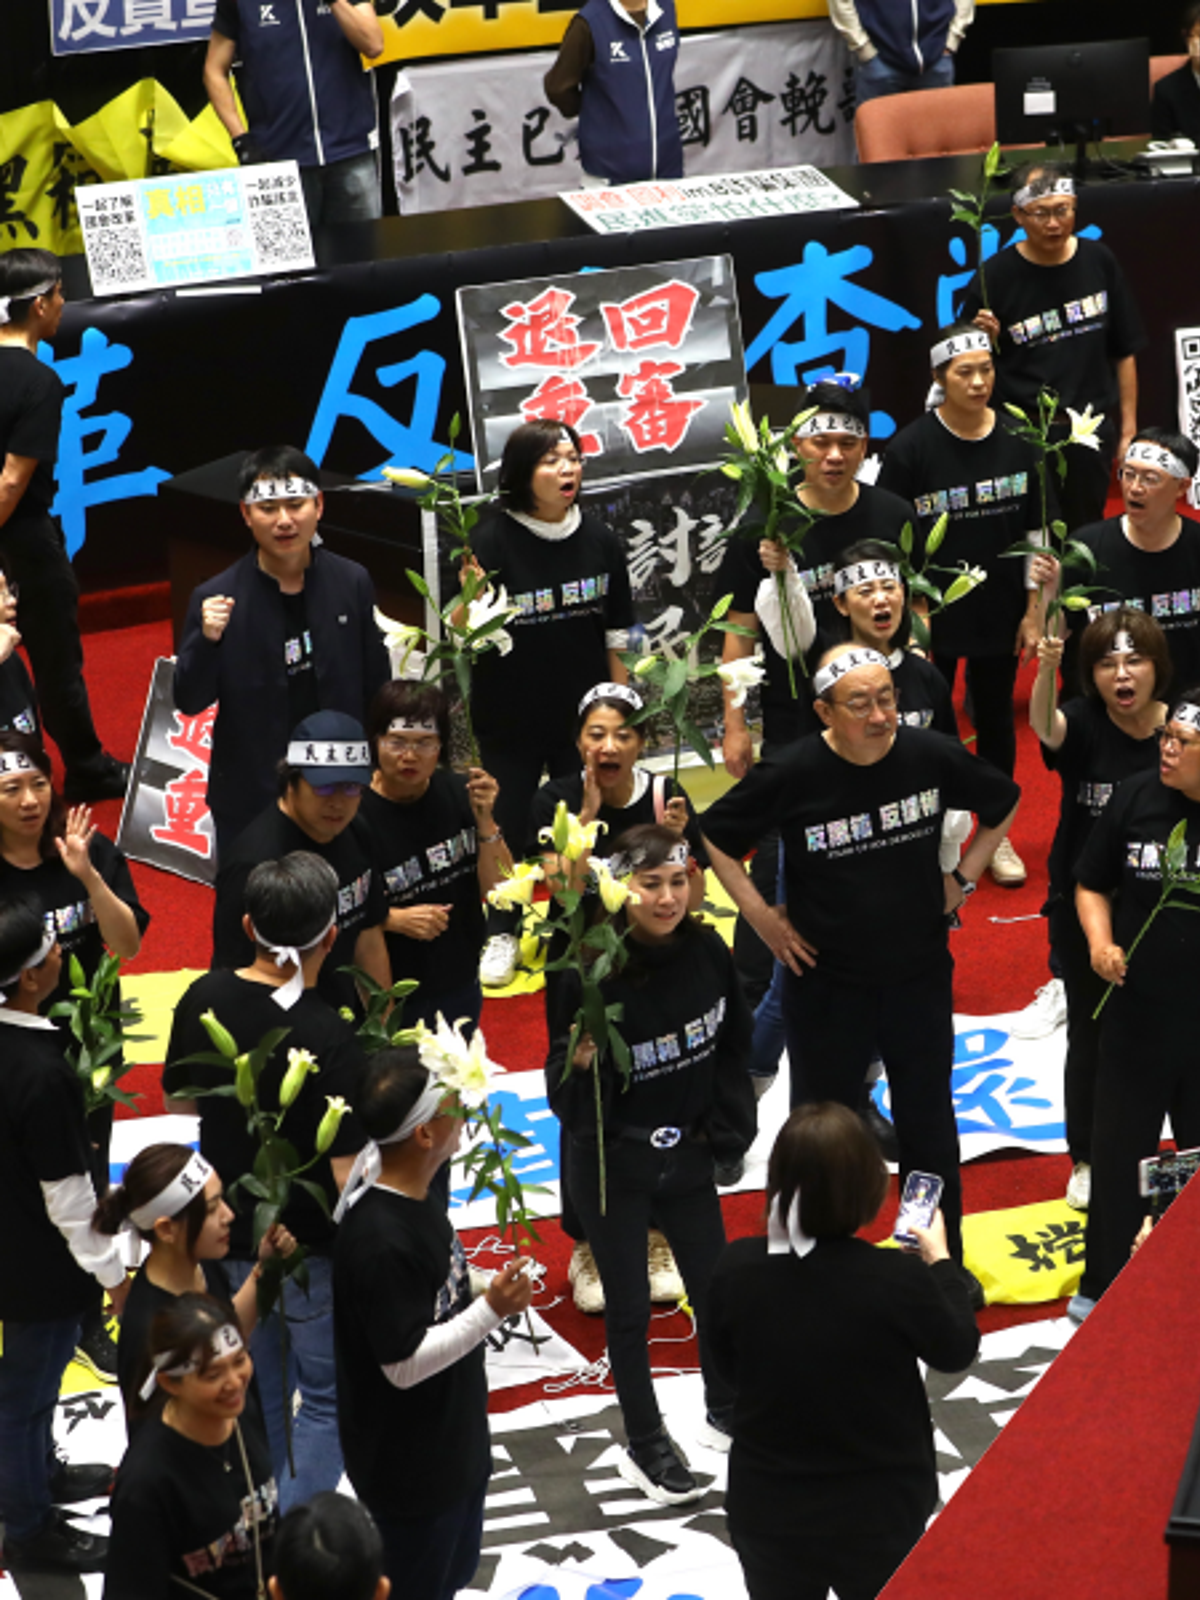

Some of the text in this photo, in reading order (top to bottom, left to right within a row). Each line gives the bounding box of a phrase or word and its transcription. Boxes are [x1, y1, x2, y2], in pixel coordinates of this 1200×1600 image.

[401, 106, 568, 182] 民主已
[144, 184, 206, 219] 真相
[499, 279, 701, 369] 退回
[805, 813, 874, 852] 反黑箱
